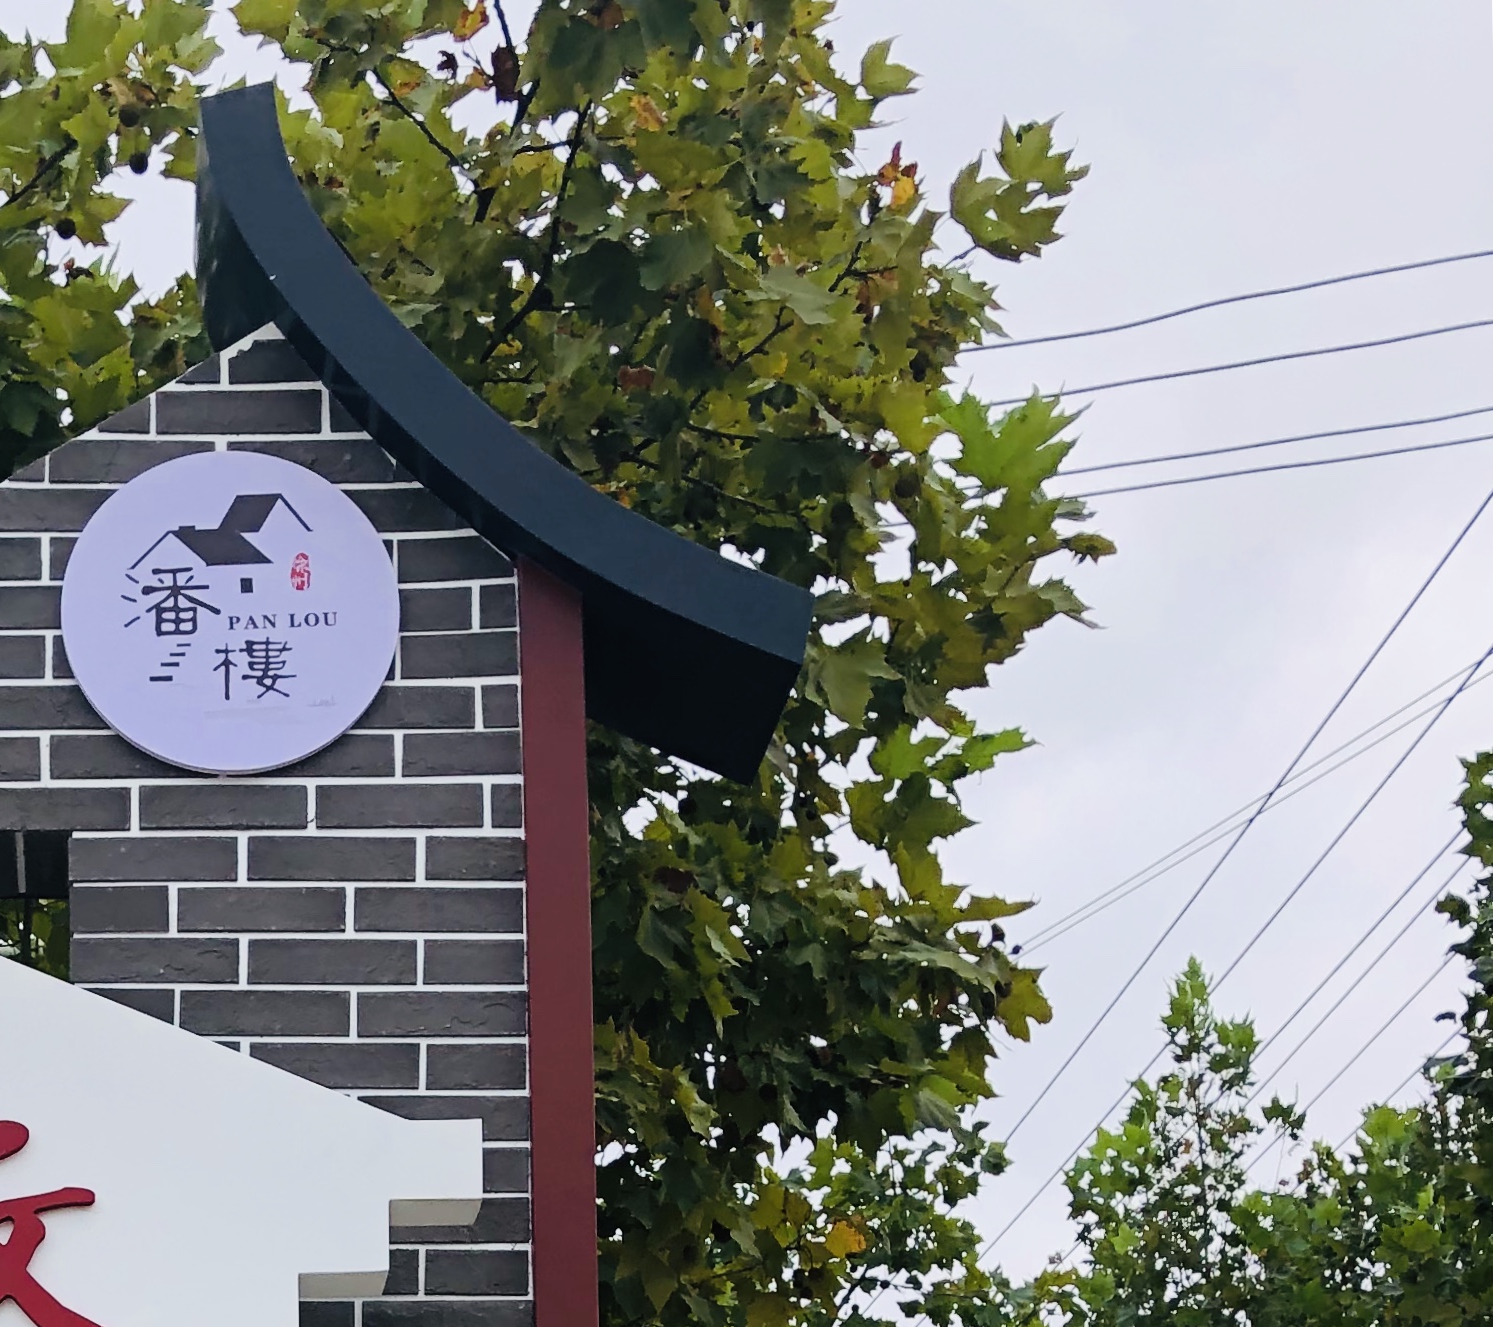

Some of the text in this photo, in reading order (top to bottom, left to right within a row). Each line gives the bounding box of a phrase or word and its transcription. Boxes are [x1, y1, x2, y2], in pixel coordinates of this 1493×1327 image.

[120, 567, 221, 637] 潘
[227, 611, 338, 631] PAN LOU
[212, 636, 297, 701] 樓
